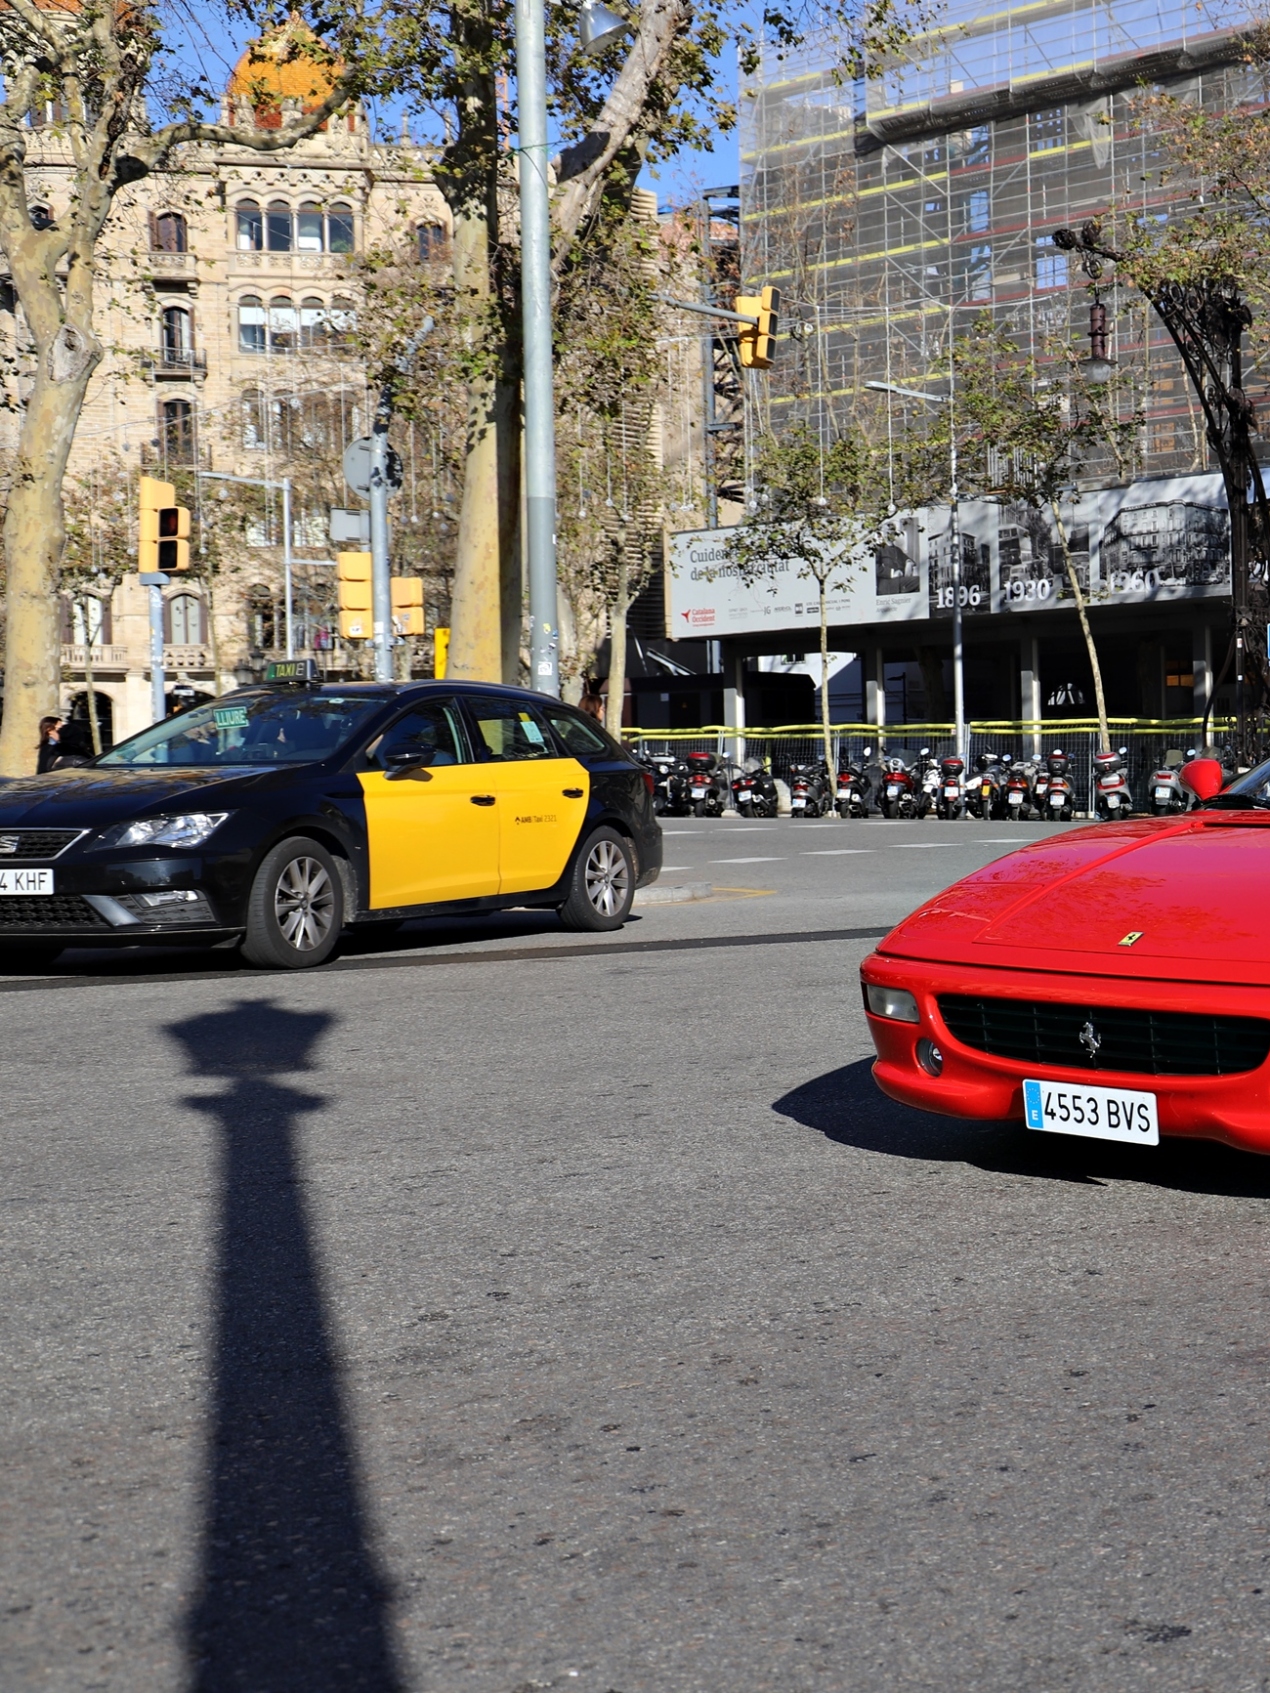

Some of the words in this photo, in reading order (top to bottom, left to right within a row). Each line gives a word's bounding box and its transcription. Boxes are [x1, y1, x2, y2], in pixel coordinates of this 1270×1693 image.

[936, 585, 981, 608] 1896
[1004, 578, 1050, 602] 1930
[276, 663, 295, 677] TAXI
[14, 872, 48, 891] KHF
[1032, 1109, 1039, 1121] E
[1044, 1091, 1100, 1126] 4553
[1106, 1099, 1151, 1133] BVS
